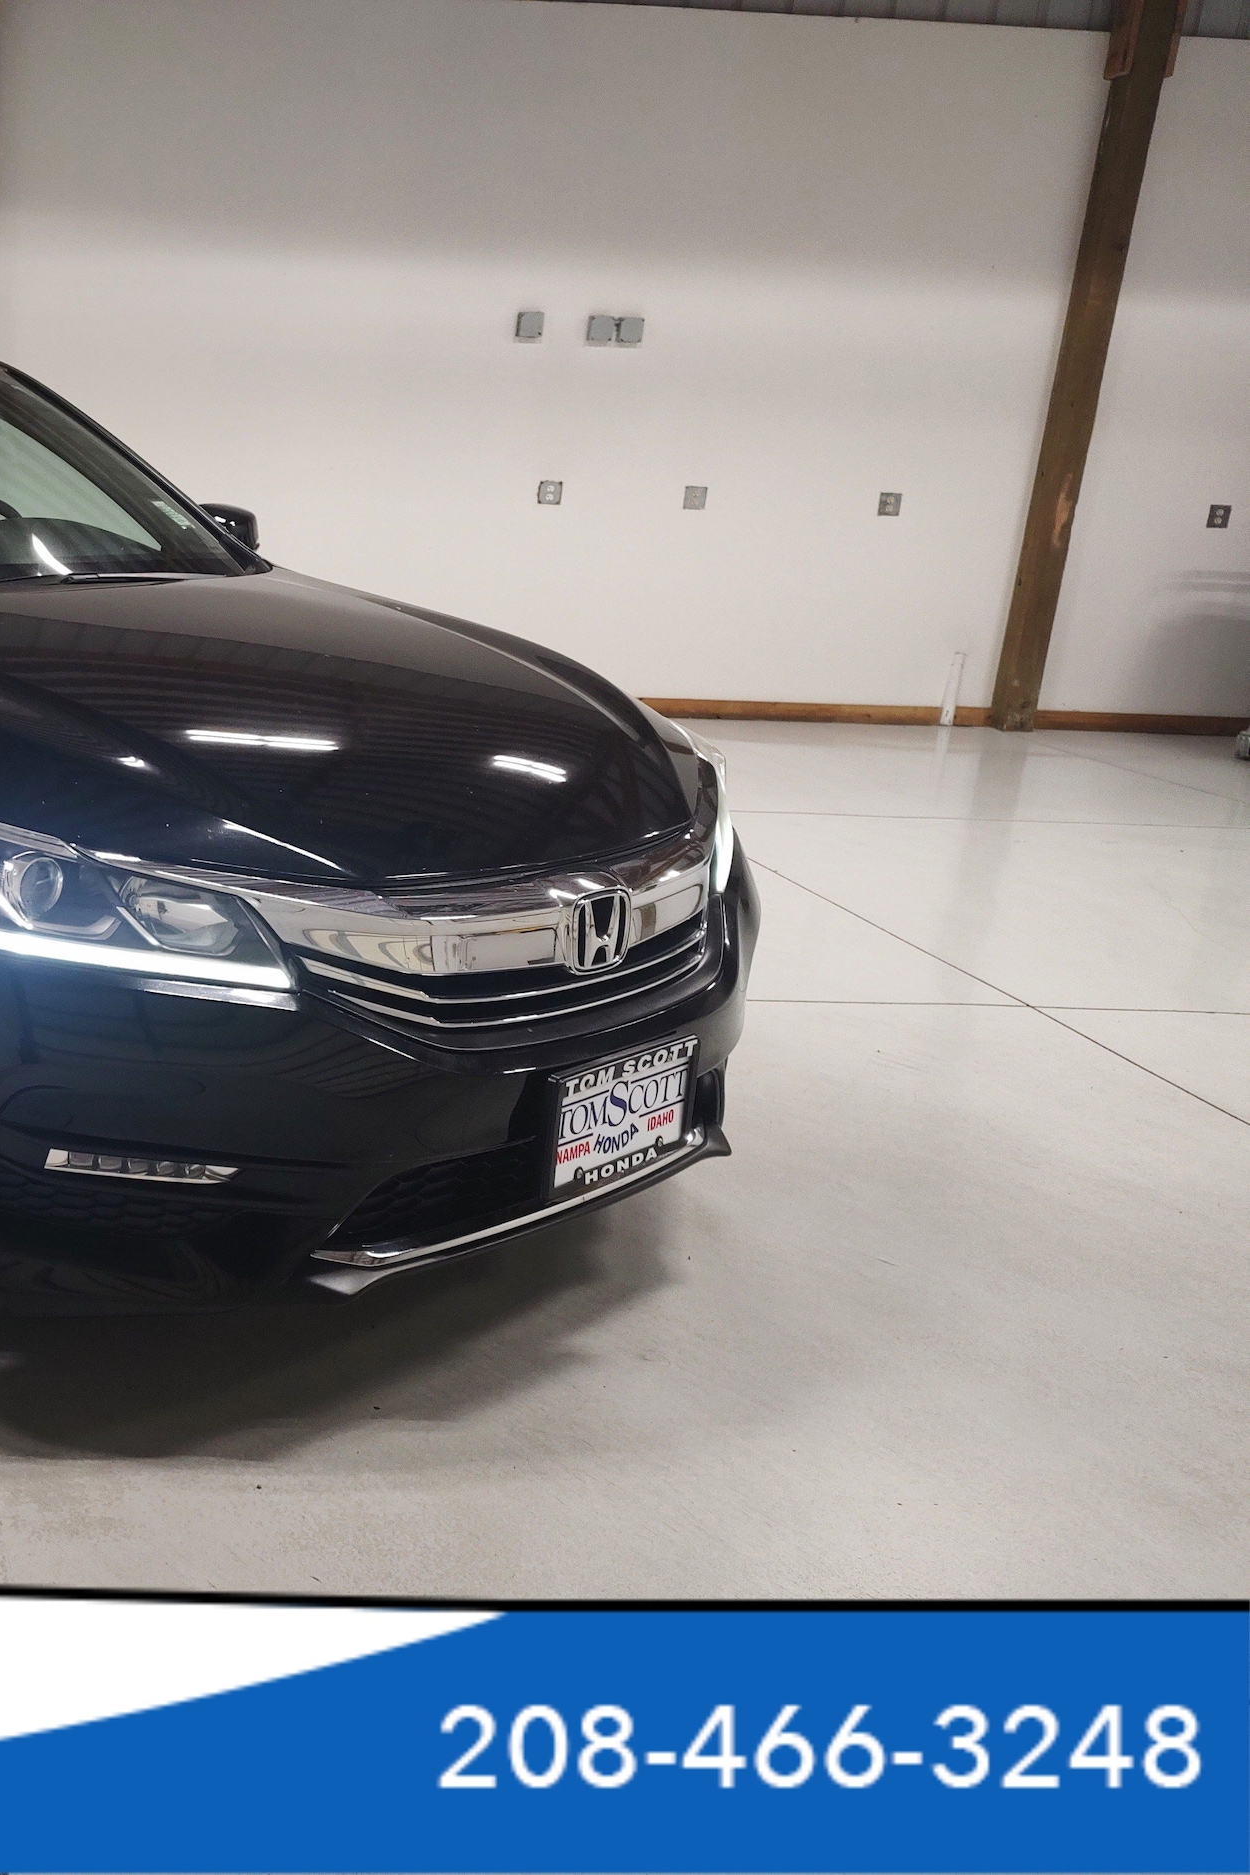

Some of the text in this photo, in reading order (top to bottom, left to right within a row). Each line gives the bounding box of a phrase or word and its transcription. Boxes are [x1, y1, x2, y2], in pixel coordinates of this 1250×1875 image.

[565, 1039, 698, 1095] TOM SCOTT
[557, 1109, 674, 1165] NAMPA HONDA IDAHO
[584, 1147, 658, 1185] HONDA
